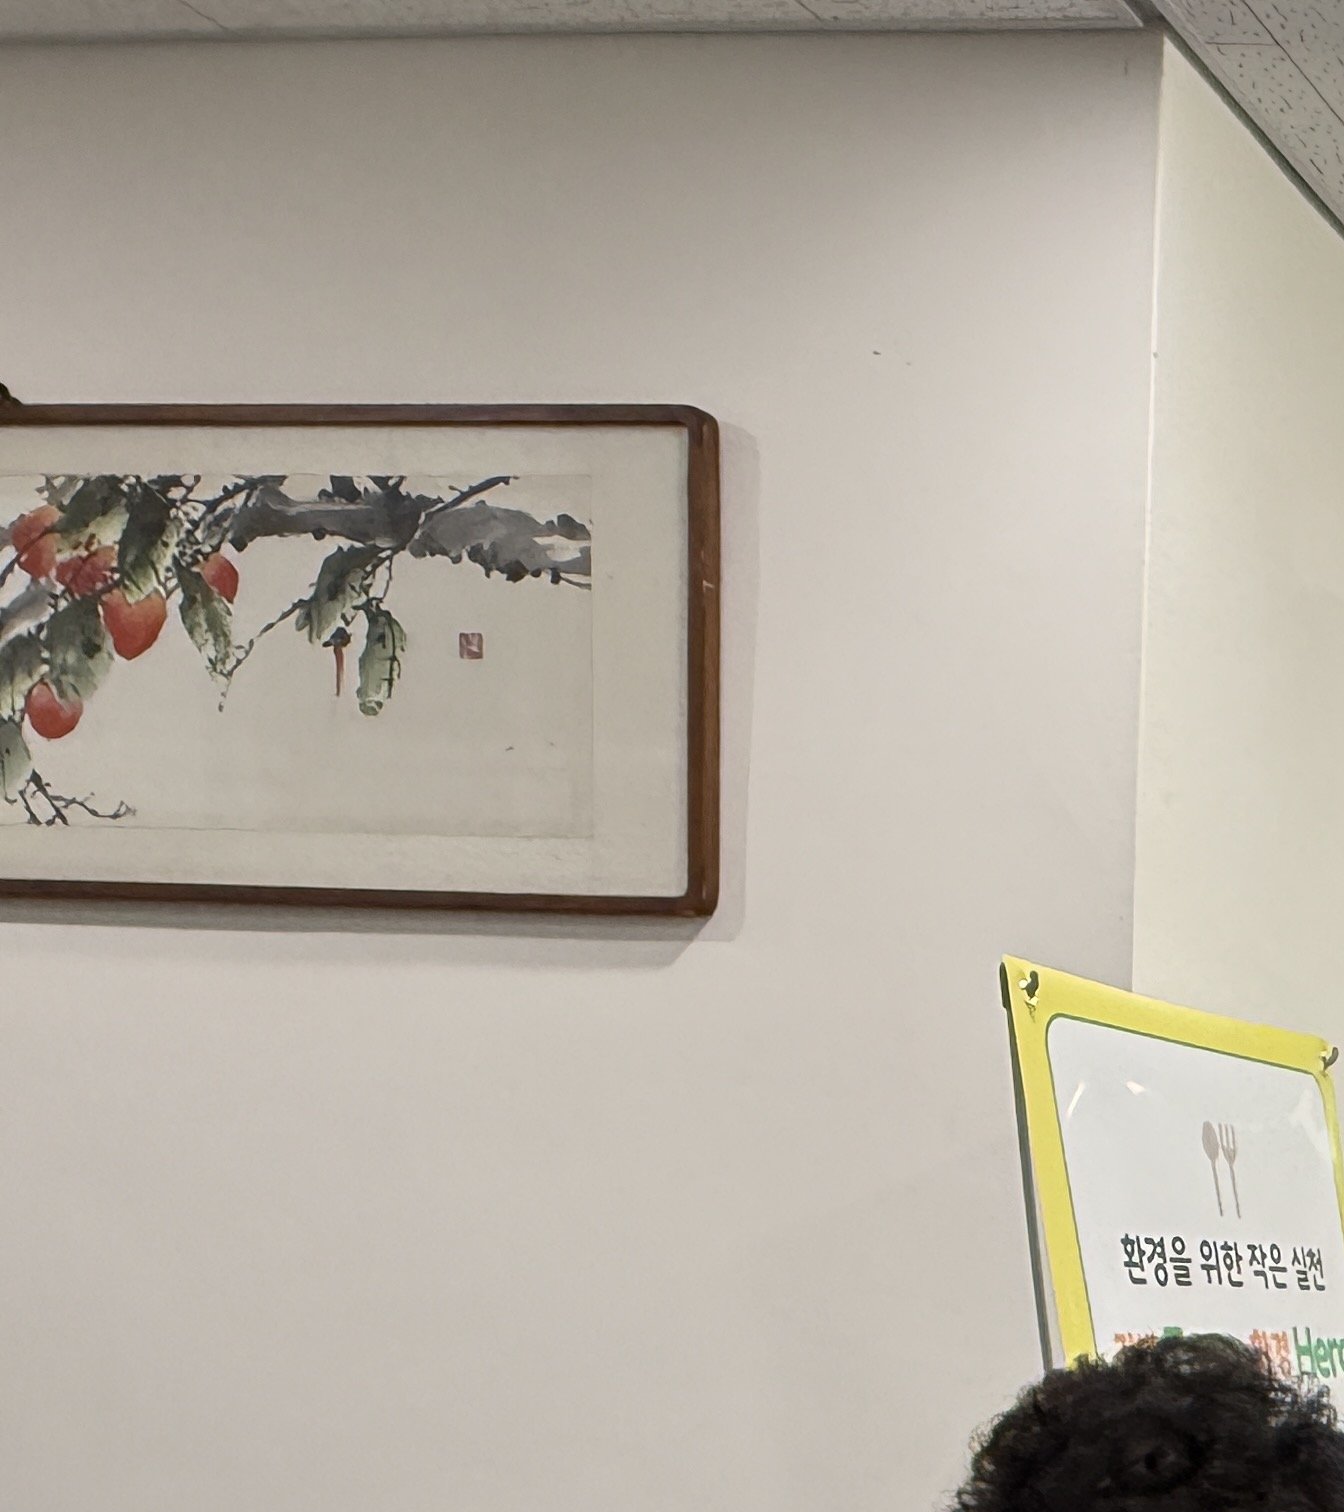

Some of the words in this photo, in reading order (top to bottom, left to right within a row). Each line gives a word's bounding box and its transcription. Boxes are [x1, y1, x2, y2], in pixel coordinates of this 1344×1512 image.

[1121, 1233, 1192, 1287] 환경을
[1200, 1239, 1244, 1288] 위한
[1247, 1243, 1287, 1289] 작은
[1292, 1246, 1326, 1291] 실천
